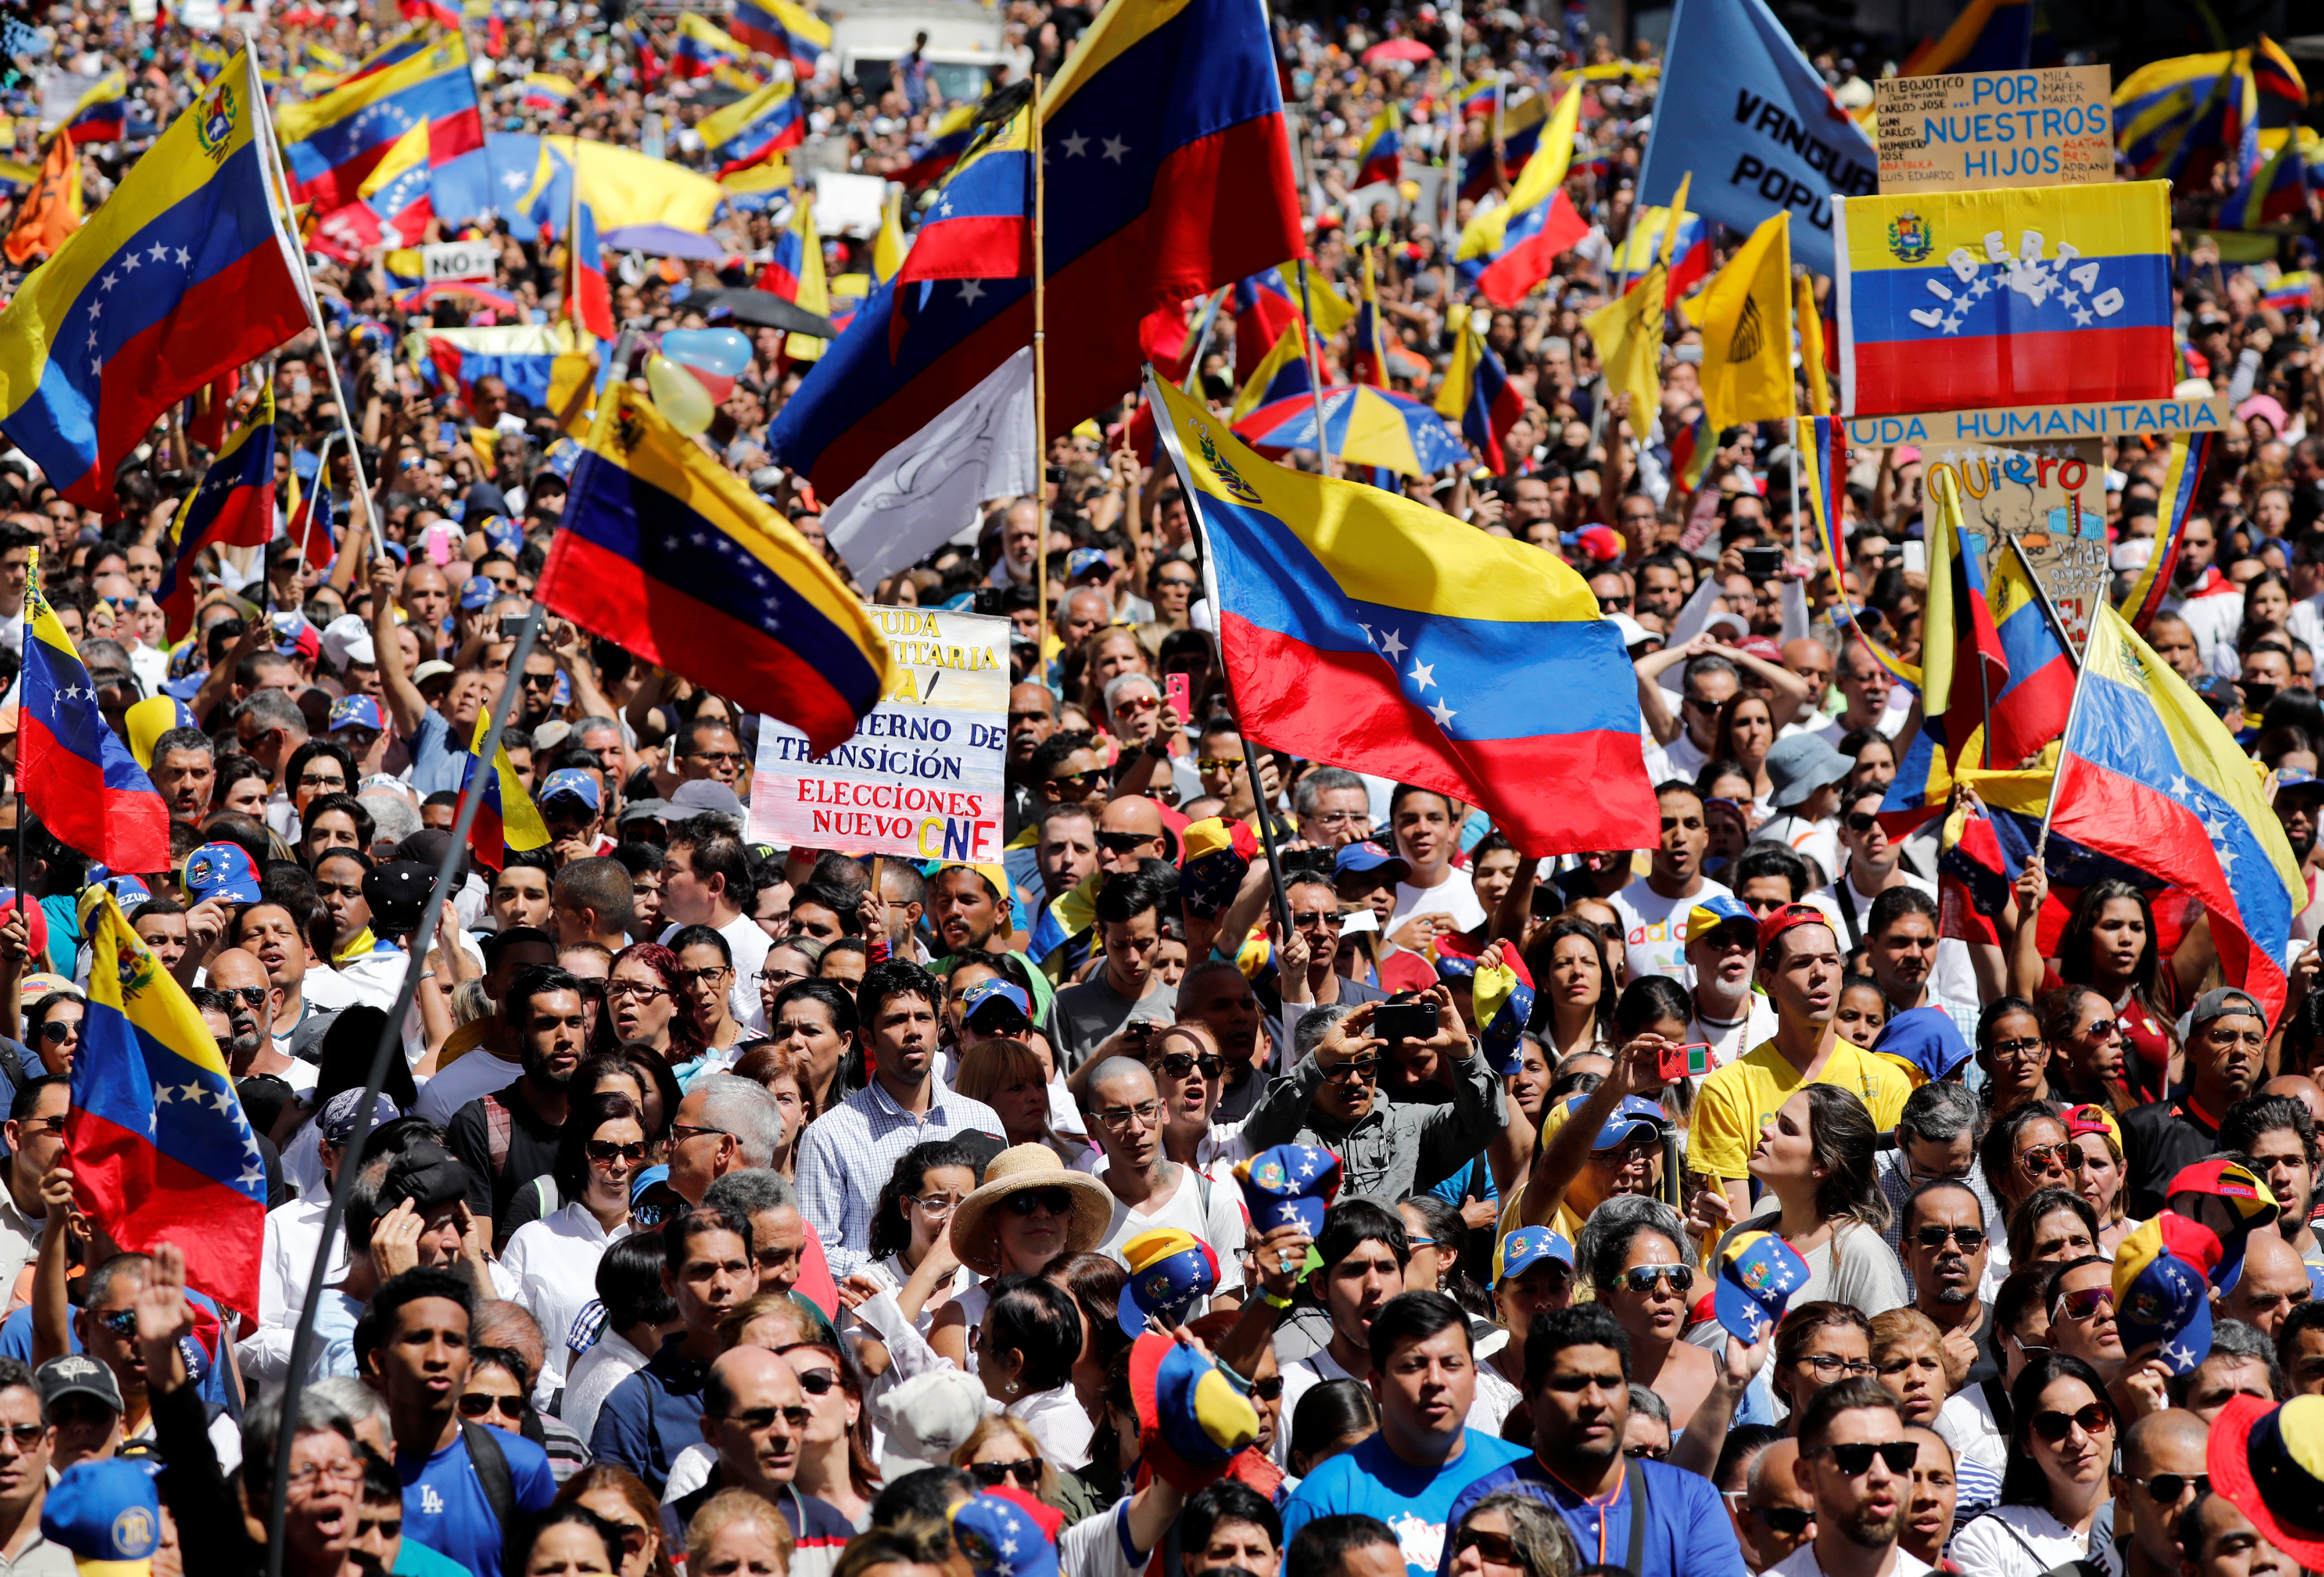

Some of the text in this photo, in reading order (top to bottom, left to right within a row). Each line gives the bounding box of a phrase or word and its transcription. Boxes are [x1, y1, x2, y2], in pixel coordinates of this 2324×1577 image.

[2042, 81, 2085, 93] MAFER
[2042, 94, 2084, 104] MARTA
[1878, 100, 1946, 114] CARLOS JOSE
[1925, 103, 2106, 144] NUESTROS
[1878, 125, 1916, 137] CARLOS
[1880, 138, 1926, 151] HUMBERTO
[1880, 151, 1904, 161] JOSE
[1965, 145, 2060, 177] HIJOS
[1880, 170, 1955, 182] LUIS EDUARDO
[2062, 172, 2092, 182] DANI
[1730, 152, 1833, 231] POPU
[1910, 230, 2124, 328] LIBERTAD
[1843, 402, 2218, 444] UDA HUMANITARIA
[969, 723, 1007, 751] DE
[813, 809, 996, 862] NUEVO CNE
[2220, 1187, 2252, 1197] VENEZUELA
[420, 1484, 444, 1513] LA
